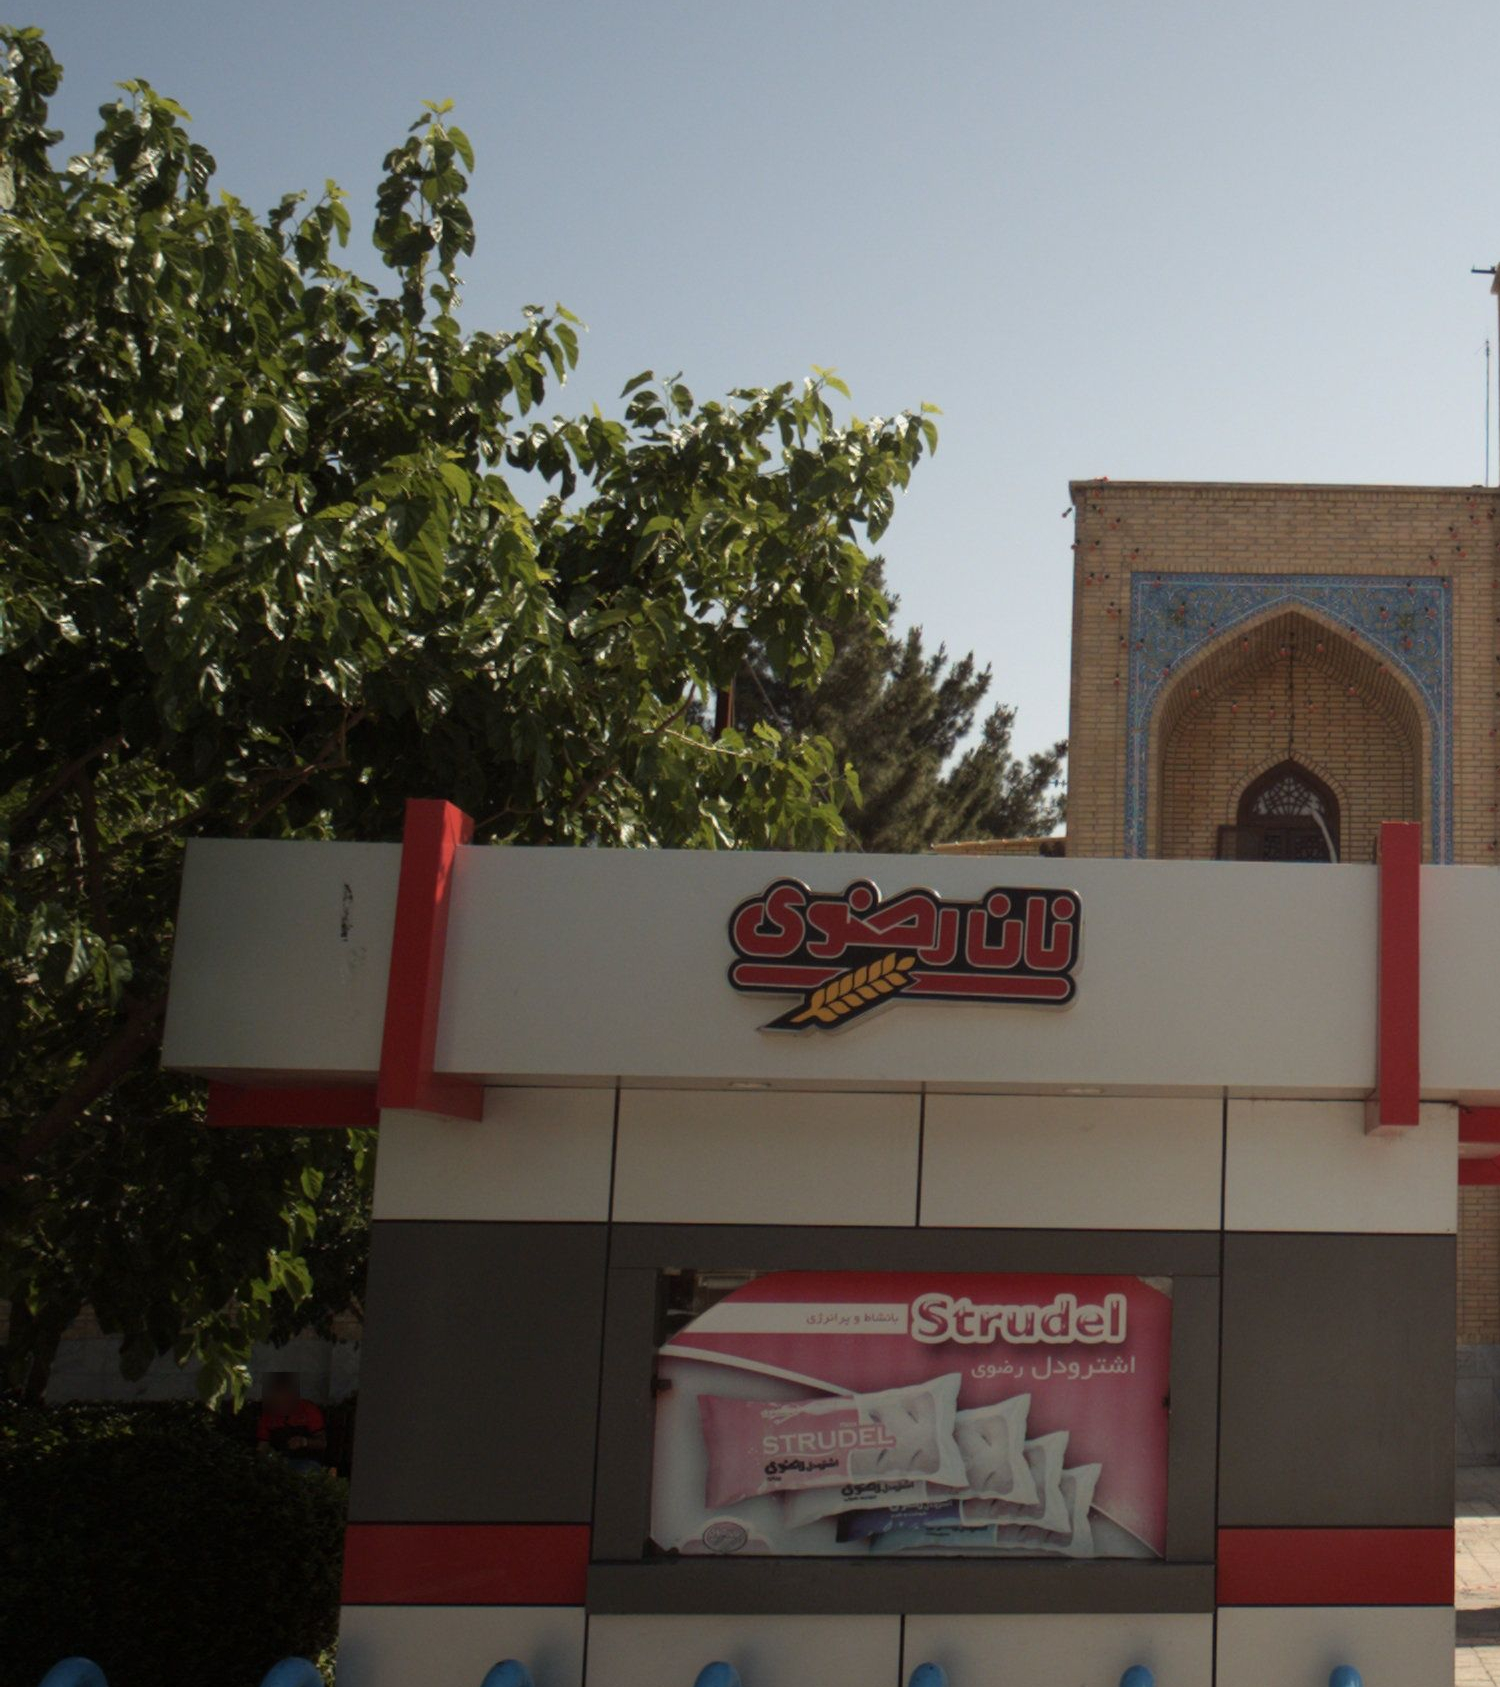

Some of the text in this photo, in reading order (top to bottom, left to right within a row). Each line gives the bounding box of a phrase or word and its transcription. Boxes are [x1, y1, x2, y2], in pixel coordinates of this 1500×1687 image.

[732, 885, 1075, 971] نان رضوی
[914, 1295, 1124, 1341] Strudel
[970, 1355, 1136, 1380] اشترودل رضوی
[762, 1424, 895, 1455] STRUDEL
